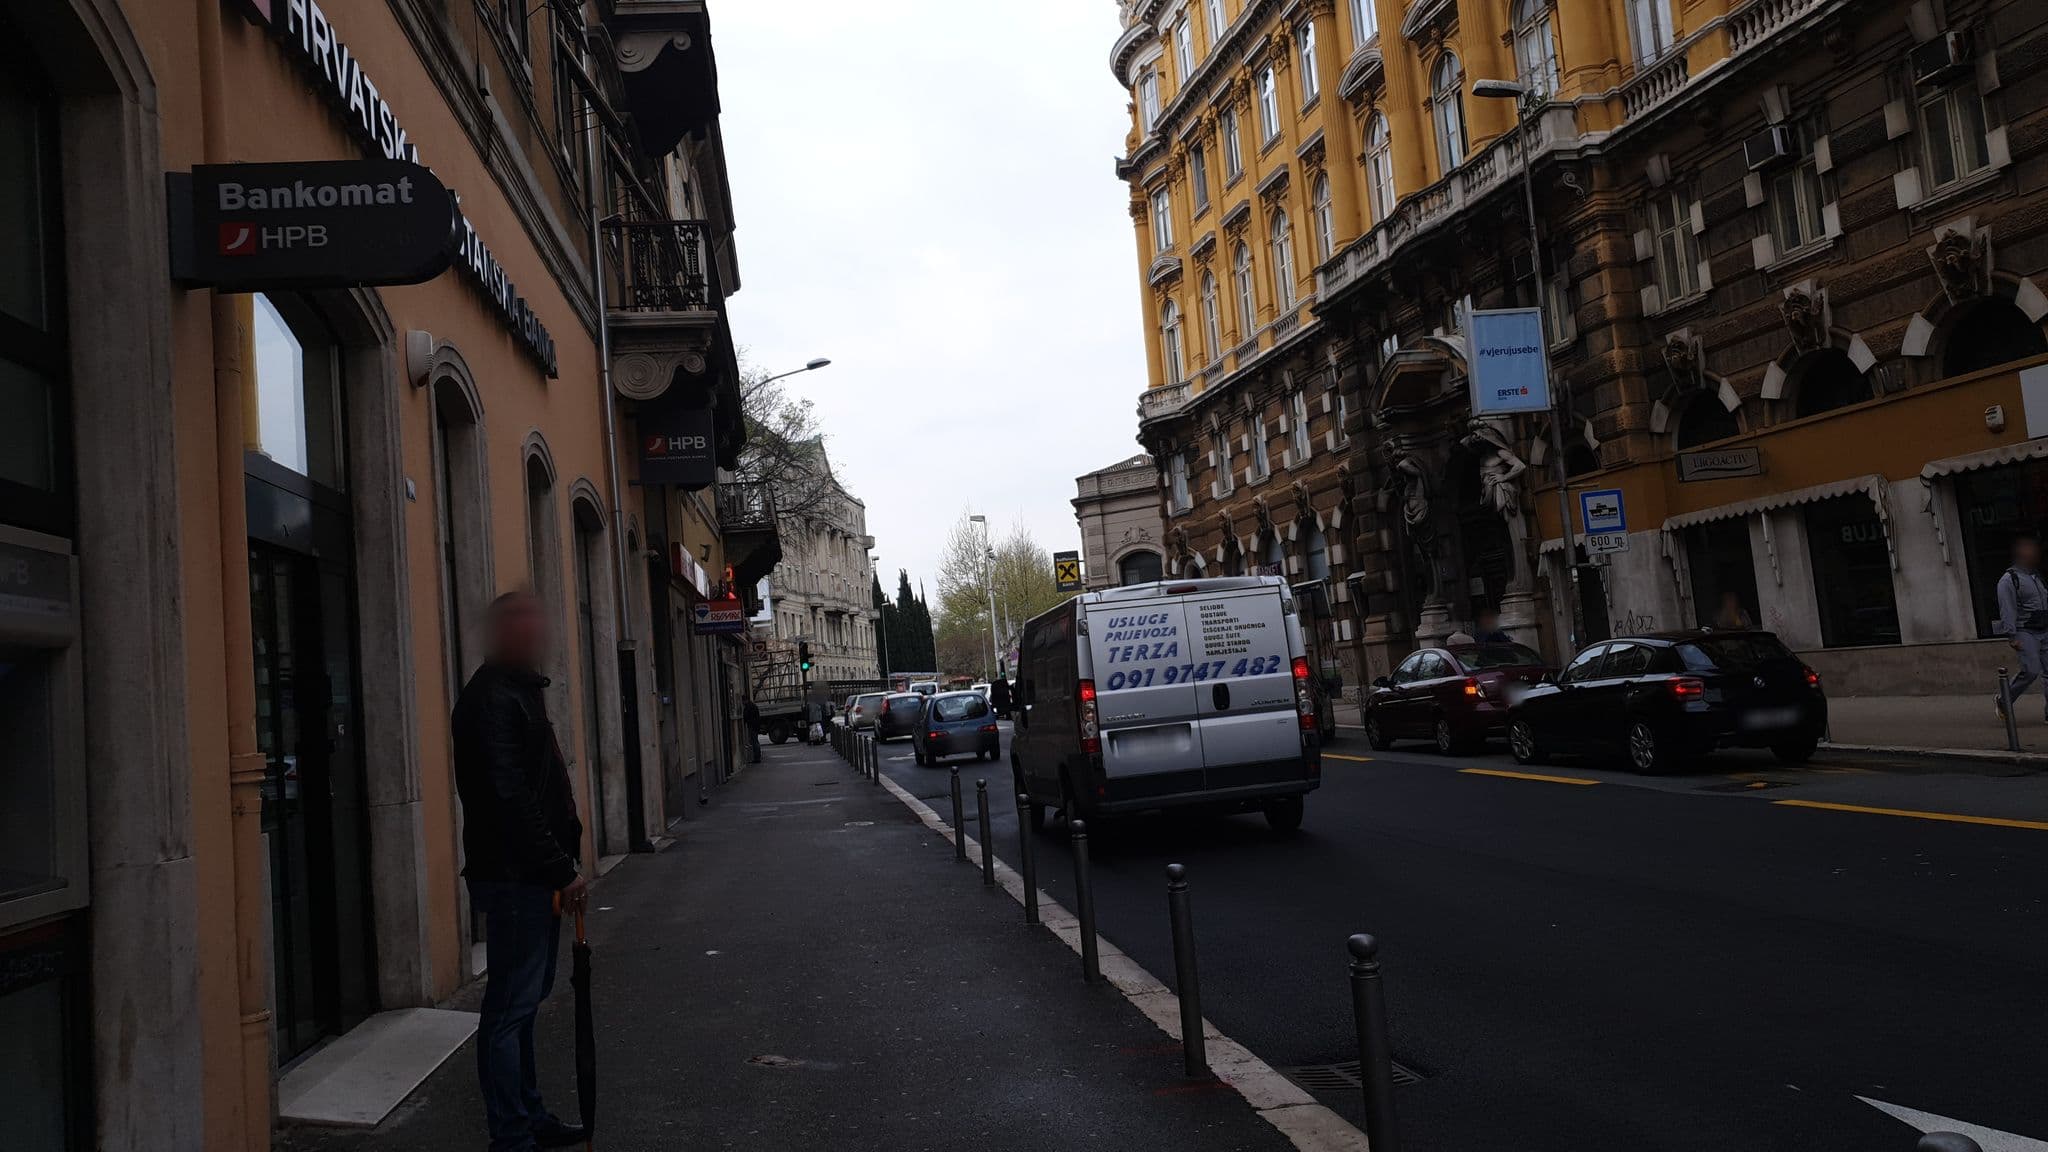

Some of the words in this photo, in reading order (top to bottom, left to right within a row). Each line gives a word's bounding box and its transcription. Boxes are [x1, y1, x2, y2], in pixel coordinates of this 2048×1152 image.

[218, 175, 414, 211] Bankomat
[261, 224, 328, 249] HPB
[1479, 345, 1539, 357] #vjerujusebe
[1497, 388, 1520, 397] ERSTE
[668, 436, 706, 450] HPB
[1591, 535, 1610, 547] 600
[1109, 613, 1168, 628] USLUGE
[1104, 626, 1177, 642] PRIJEVOZA
[1108, 642, 1178, 663] TERZA
[1107, 668, 1155, 690] 091
[1164, 661, 1226, 684] 9747
[1232, 655, 1281, 677] 482
